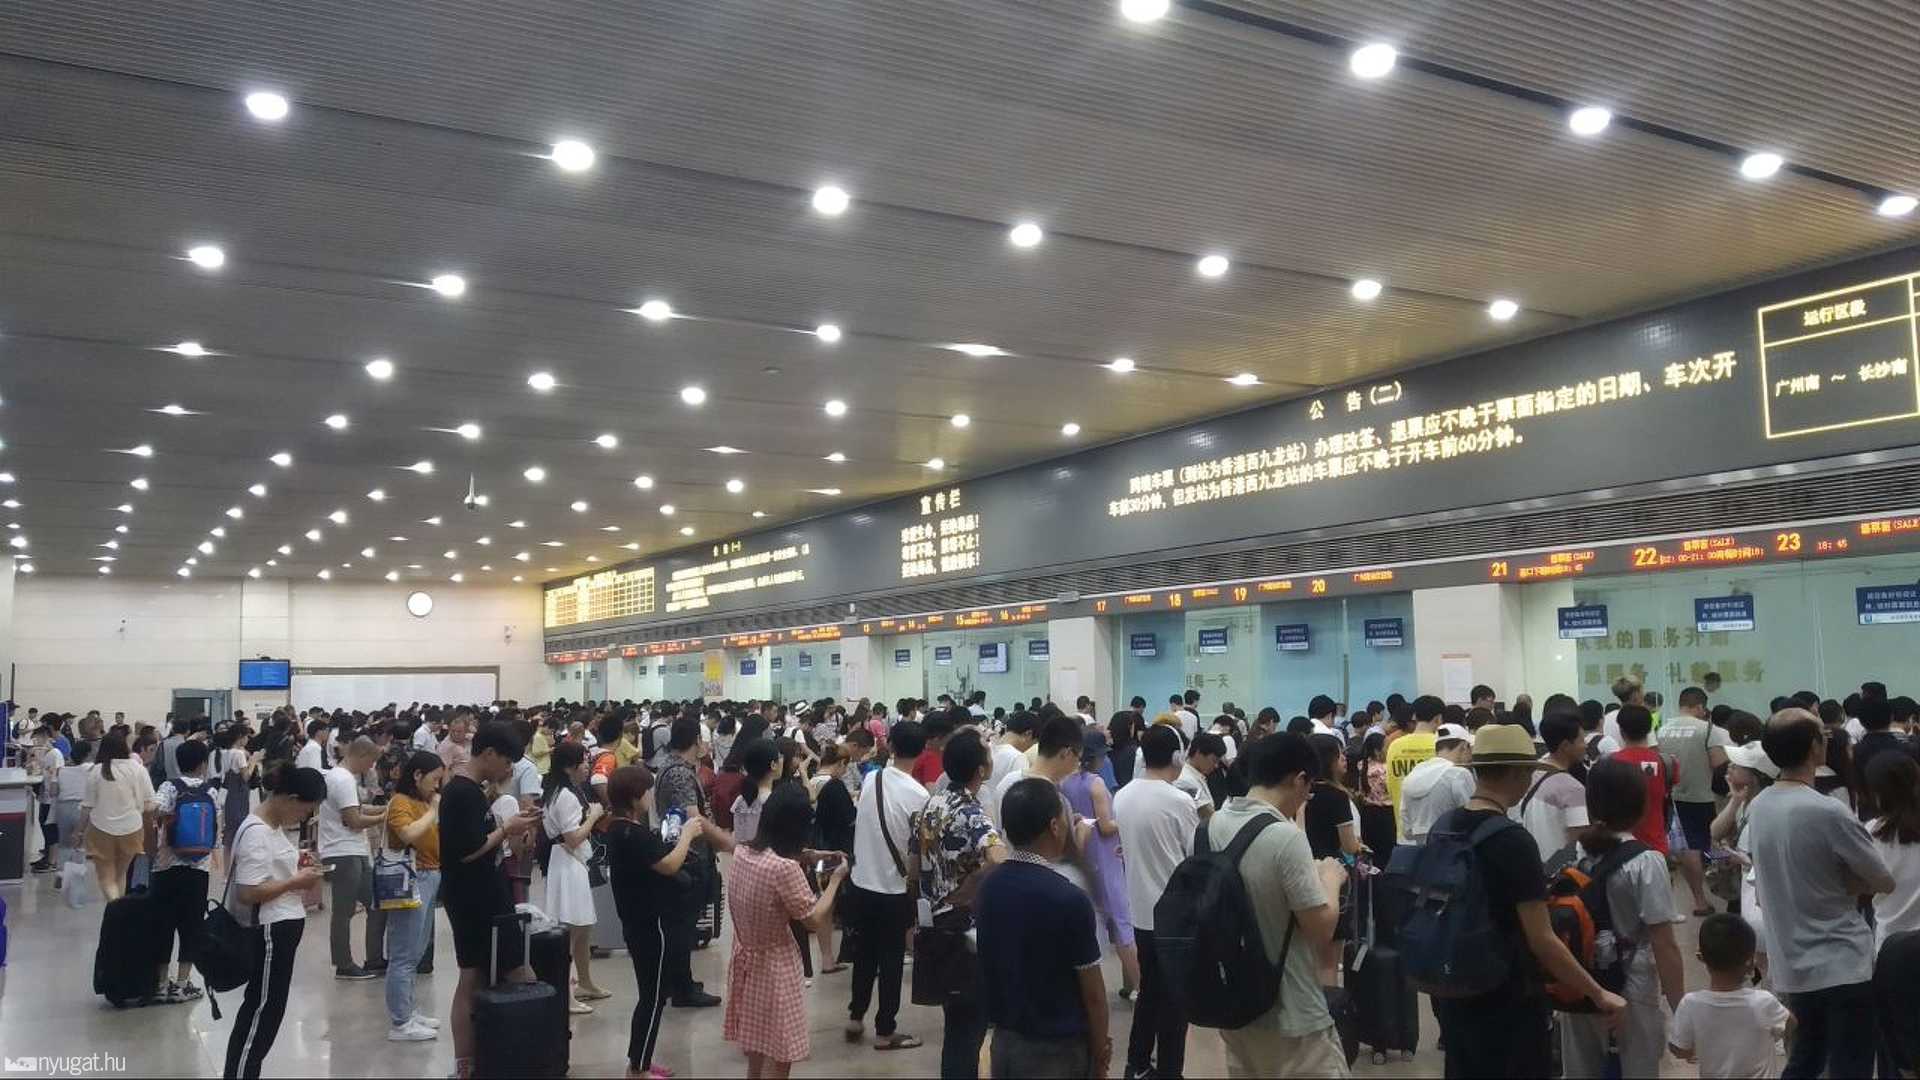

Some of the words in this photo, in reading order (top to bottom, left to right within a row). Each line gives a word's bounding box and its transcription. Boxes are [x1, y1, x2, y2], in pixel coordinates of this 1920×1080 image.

[1804, 299, 1867, 326] 运行区段
[1776, 374, 1820, 397] 广州南
[1858, 358, 1908, 381] 长沙南
[1777, 532, 1801, 552] 23
[1634, 547, 1657, 566] 22
[1492, 561, 1507, 576] 21
[1312, 579, 1326, 593] 20
[1170, 593, 1181, 607] 18
[1233, 587, 1247, 601] 19
[1097, 600, 1106, 612] 17
[956, 614, 964, 625] 15
